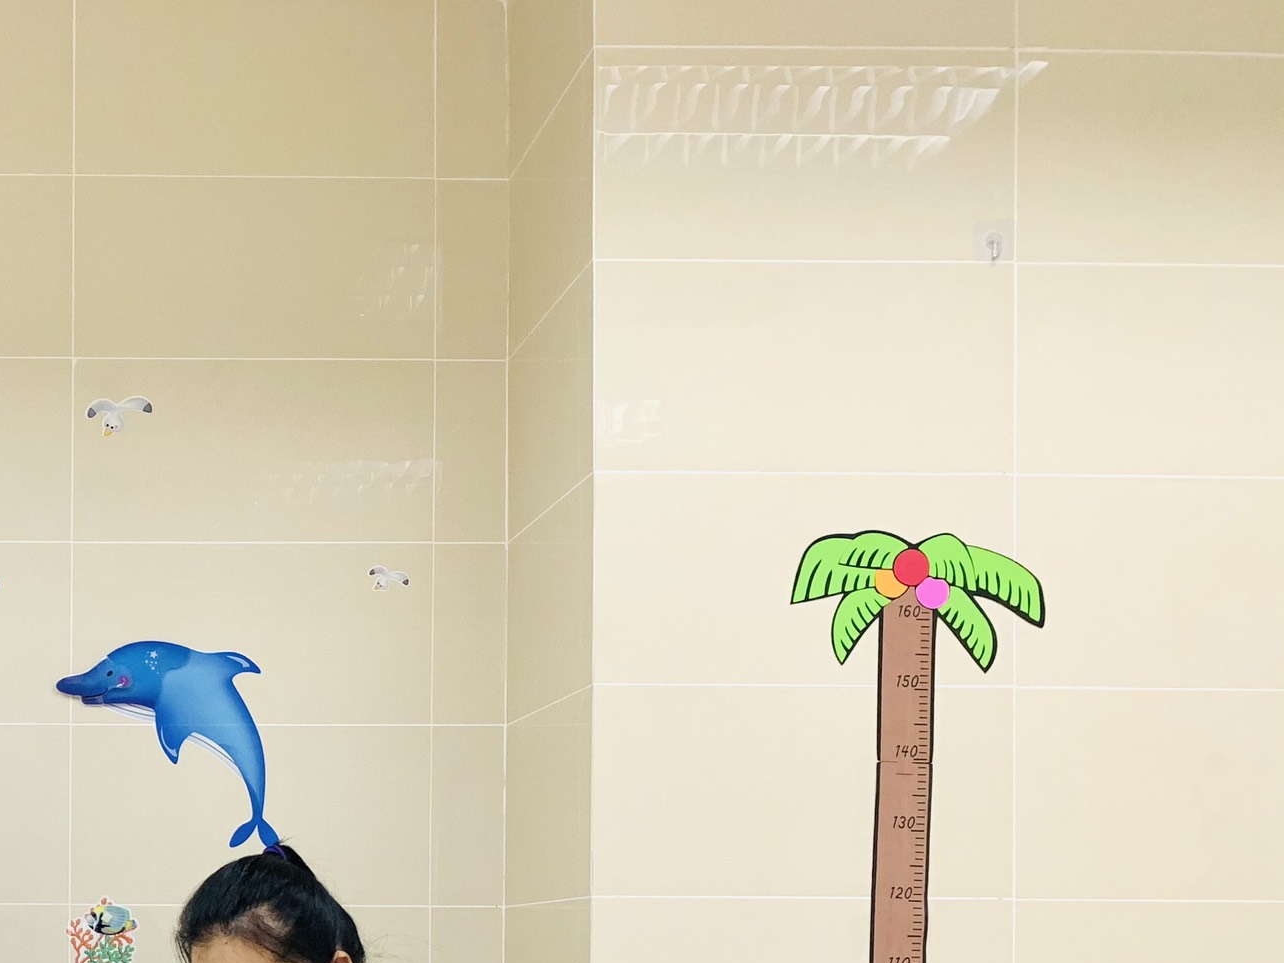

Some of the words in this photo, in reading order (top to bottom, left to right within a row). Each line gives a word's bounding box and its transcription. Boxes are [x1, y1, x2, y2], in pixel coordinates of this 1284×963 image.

[898, 604, 921, 618] 160
[896, 674, 919, 688] 150
[895, 744, 919, 758] 140
[892, 815, 916, 829] 130
[890, 886, 913, 900] 120
